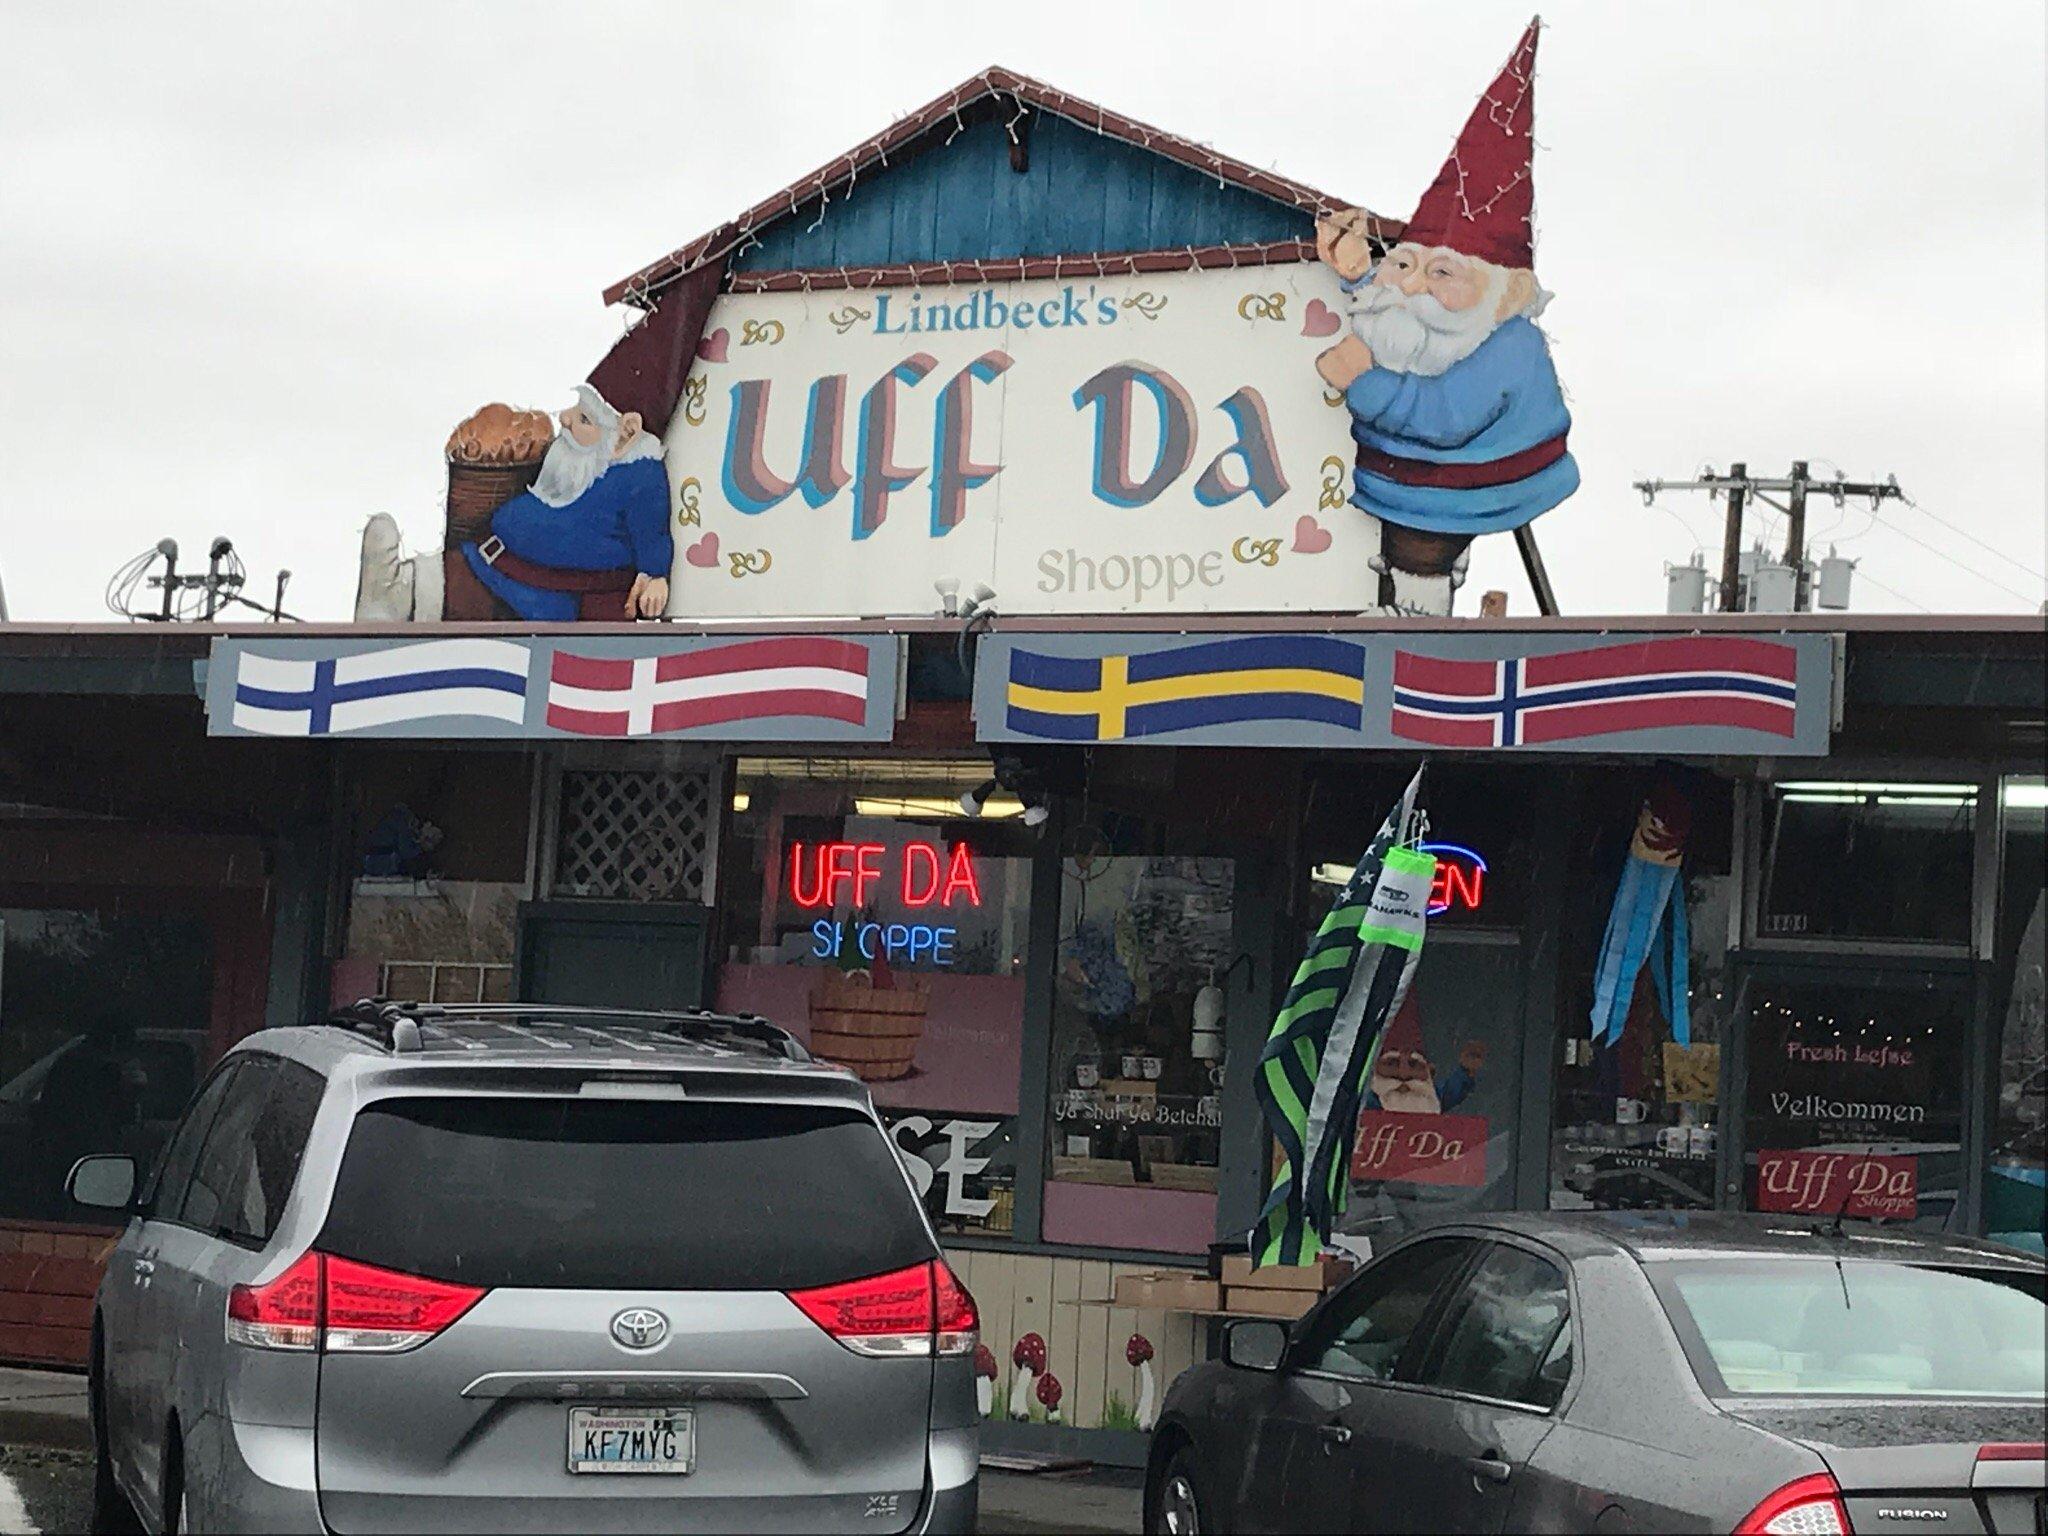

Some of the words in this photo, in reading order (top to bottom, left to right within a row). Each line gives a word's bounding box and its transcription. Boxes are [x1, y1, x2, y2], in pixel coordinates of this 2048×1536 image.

[872, 285, 1119, 336] Lindbeck's
[721, 349, 1016, 540] Uff
[1071, 360, 1291, 508] Da
[790, 842, 887, 908] UFF
[902, 841, 981, 906] DA
[1427, 861, 1484, 908] EN
[1372, 902, 1421, 919] AHAWKS
[1787, 1041, 1847, 1062] Fresh
[1854, 1044, 1915, 1068] Lefse
[1771, 1092, 1925, 1123] Velkommen
[1408, 1131, 1465, 1161] Da
[888, 1115, 1001, 1218] SE
[1761, 1155, 1845, 1209] Uff
[1847, 1161, 1913, 1196] Da
[1856, 1193, 1915, 1213] Shoppe
[584, 1430, 677, 1460] KF7MYG
[1878, 1508, 1948, 1521] FUSION
